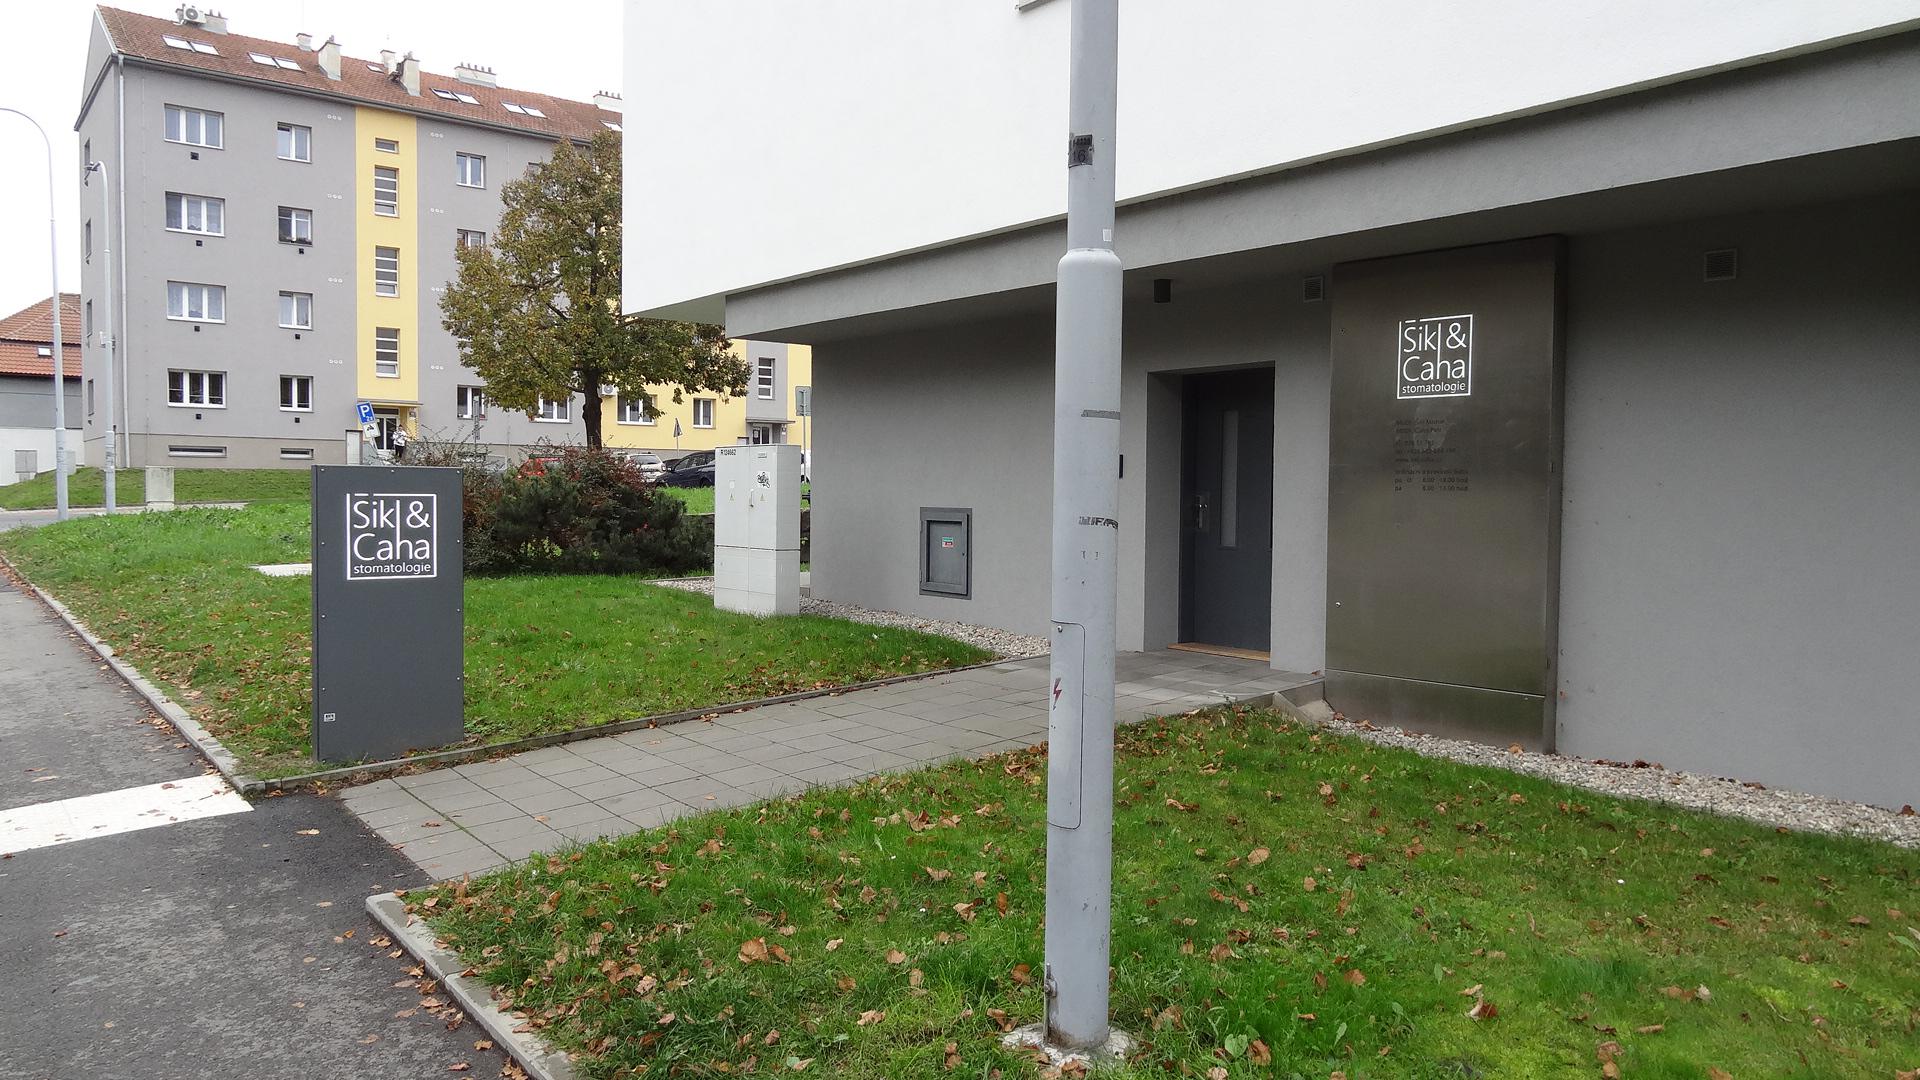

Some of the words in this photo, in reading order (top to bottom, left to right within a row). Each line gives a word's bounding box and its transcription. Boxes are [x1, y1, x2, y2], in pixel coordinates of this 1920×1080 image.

[1446, 322, 1467, 349] &
[1403, 355, 1465, 382] Caha
[1402, 381, 1466, 394] stomatologie
[360, 405, 370, 417] P
[406, 500, 431, 529] &
[353, 532, 430, 561] Caha
[353, 561, 432, 575] stomatologie
